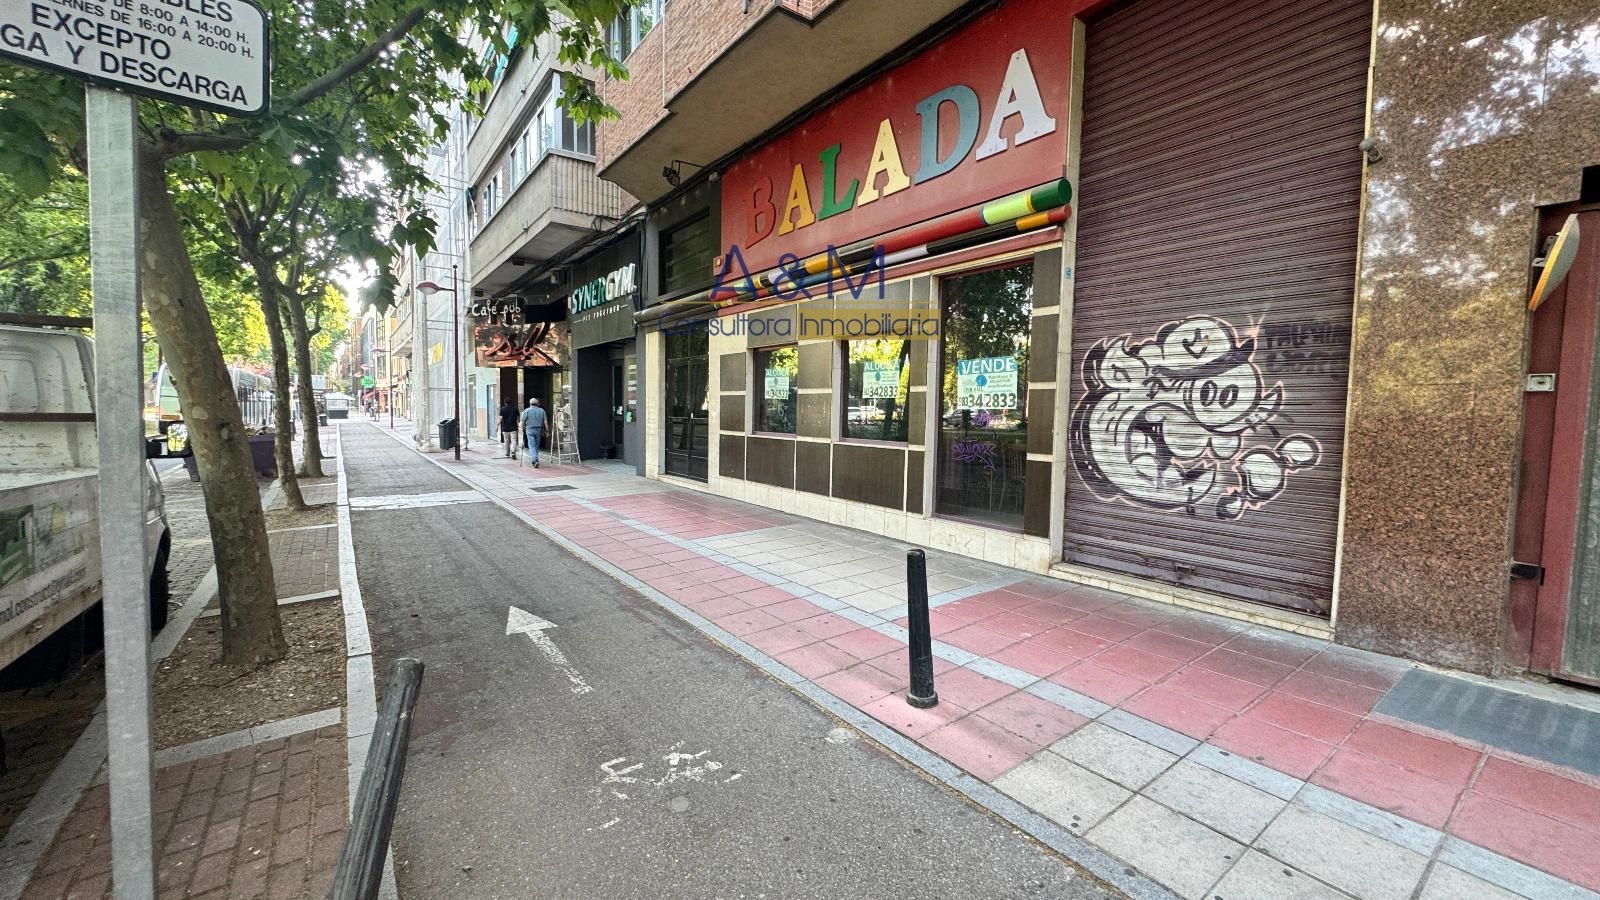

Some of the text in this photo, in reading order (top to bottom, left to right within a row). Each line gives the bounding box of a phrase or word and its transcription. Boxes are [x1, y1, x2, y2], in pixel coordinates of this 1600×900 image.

[31, 2, 171, 60] EXCEPTO
[111, 9, 131, 25] DE
[137, 18, 176, 37] 16:00
[182, 30, 192, 42] A
[198, 34, 236, 53] 20:00
[241, 46, 254, 59] H.
[139, 4, 173, 21] 8:00
[179, 16, 189, 26] A
[195, 20, 231, 38] 14:00
[236, 31, 249, 44] H.
[64, 40, 84, 65] Y
[100, 50, 248, 106] DESCARGA
[745, 48, 1056, 250] BALADA
[471, 299, 500, 324] Café
[961, 357, 1016, 375] VENDE
